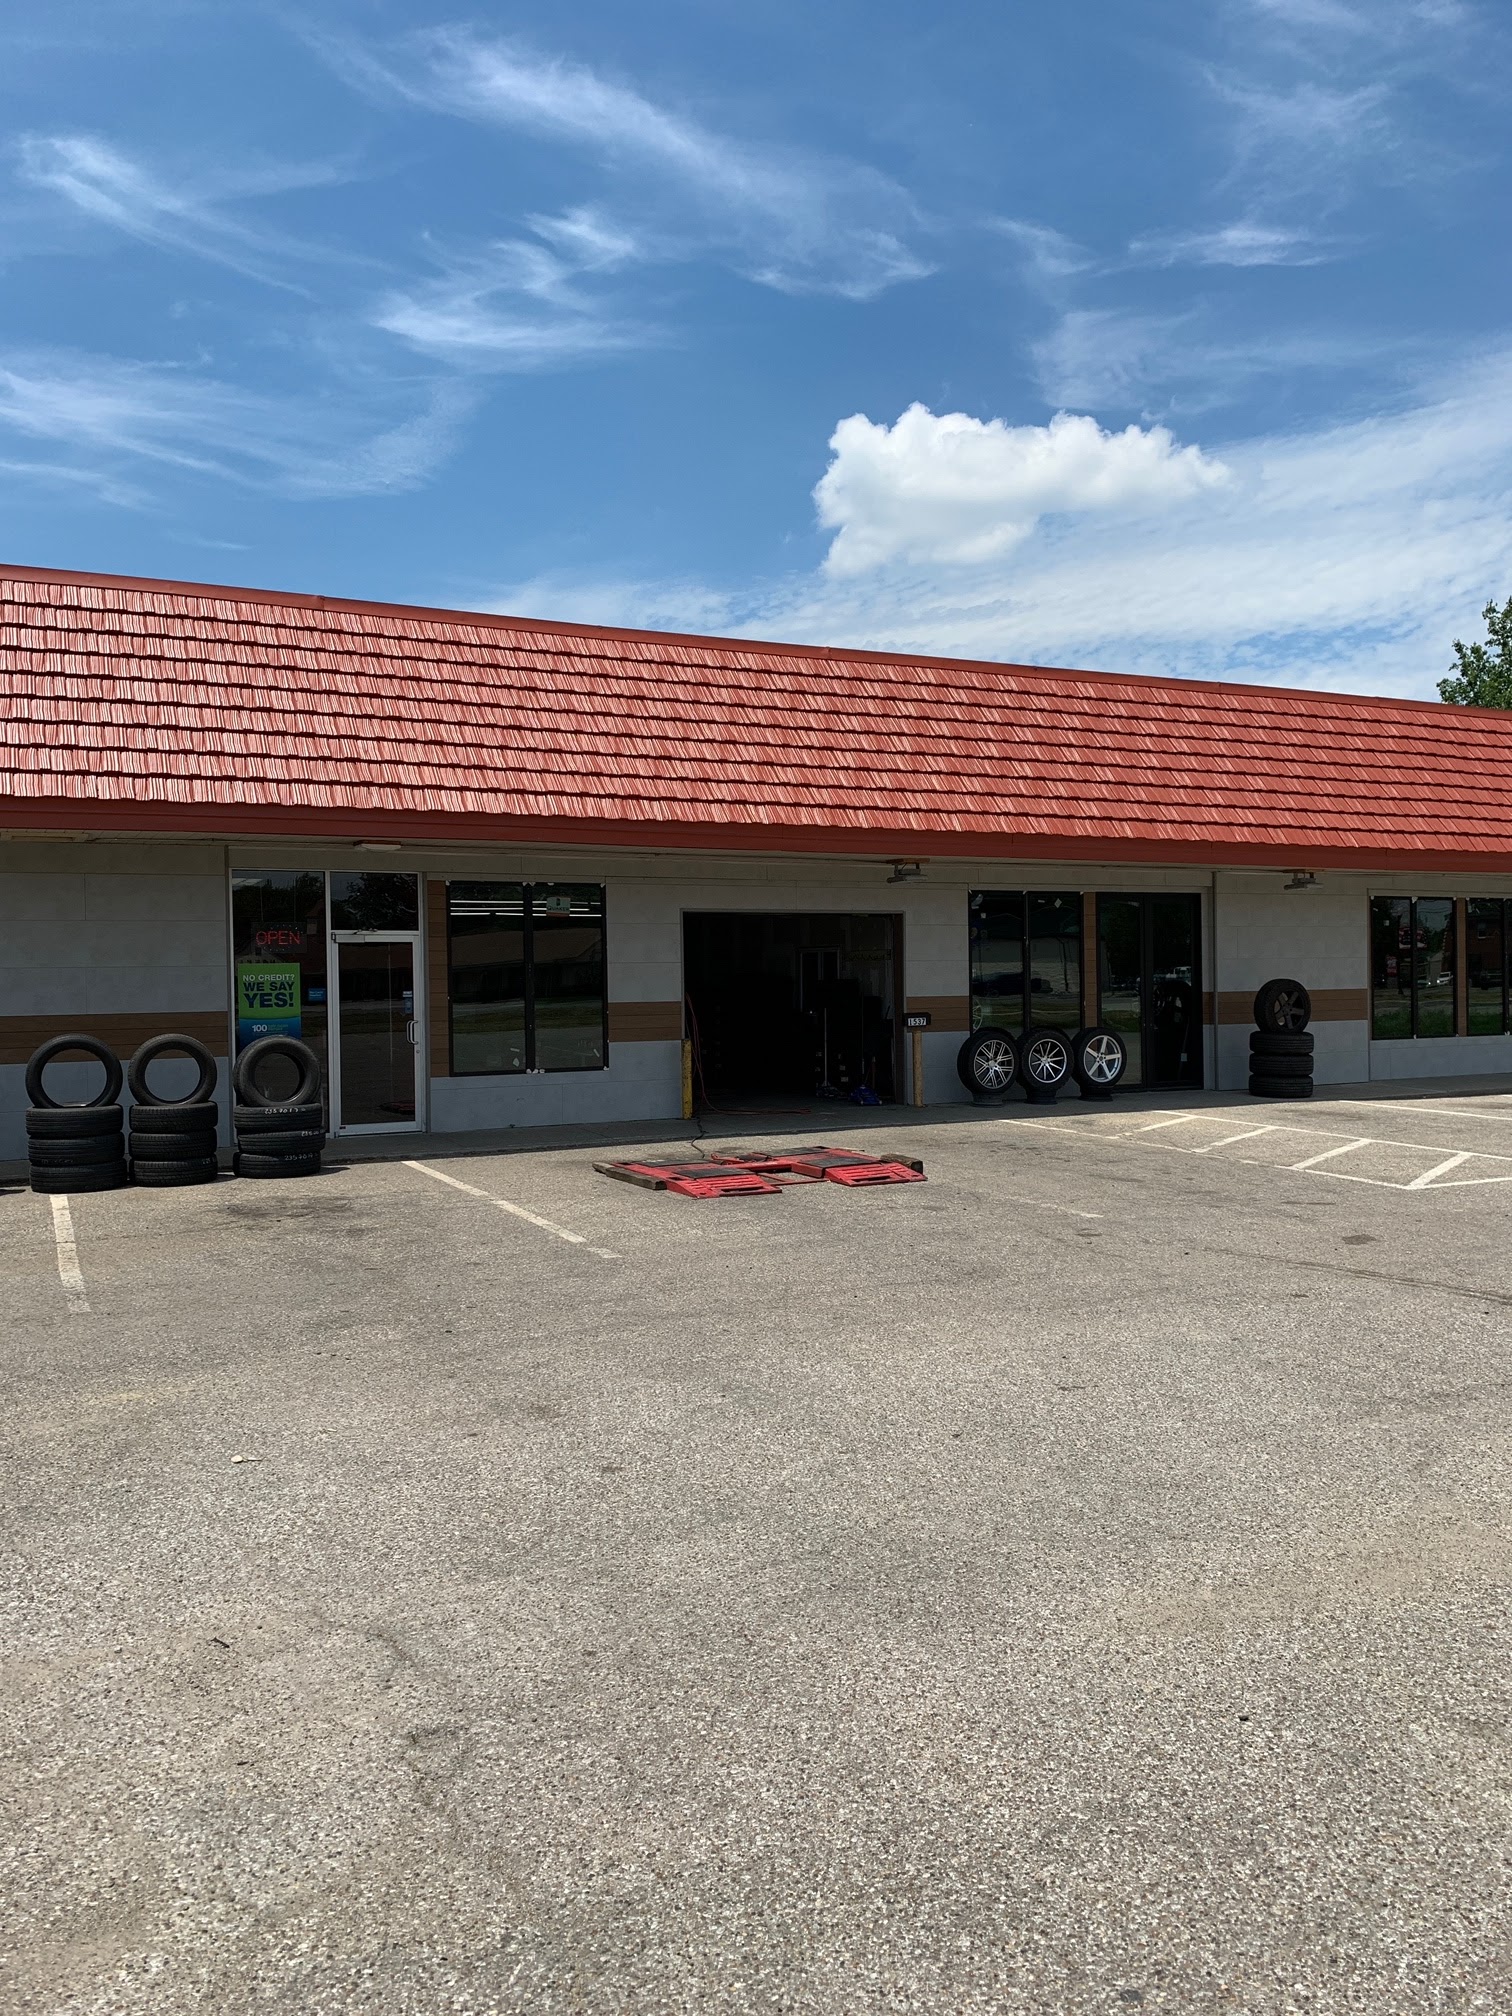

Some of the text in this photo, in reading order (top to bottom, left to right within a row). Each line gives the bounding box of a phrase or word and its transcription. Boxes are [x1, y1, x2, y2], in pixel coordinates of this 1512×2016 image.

[255, 931, 301, 945] OPEN
[243, 982, 295, 991] WE SAY
[243, 992, 294, 1009] YES!
